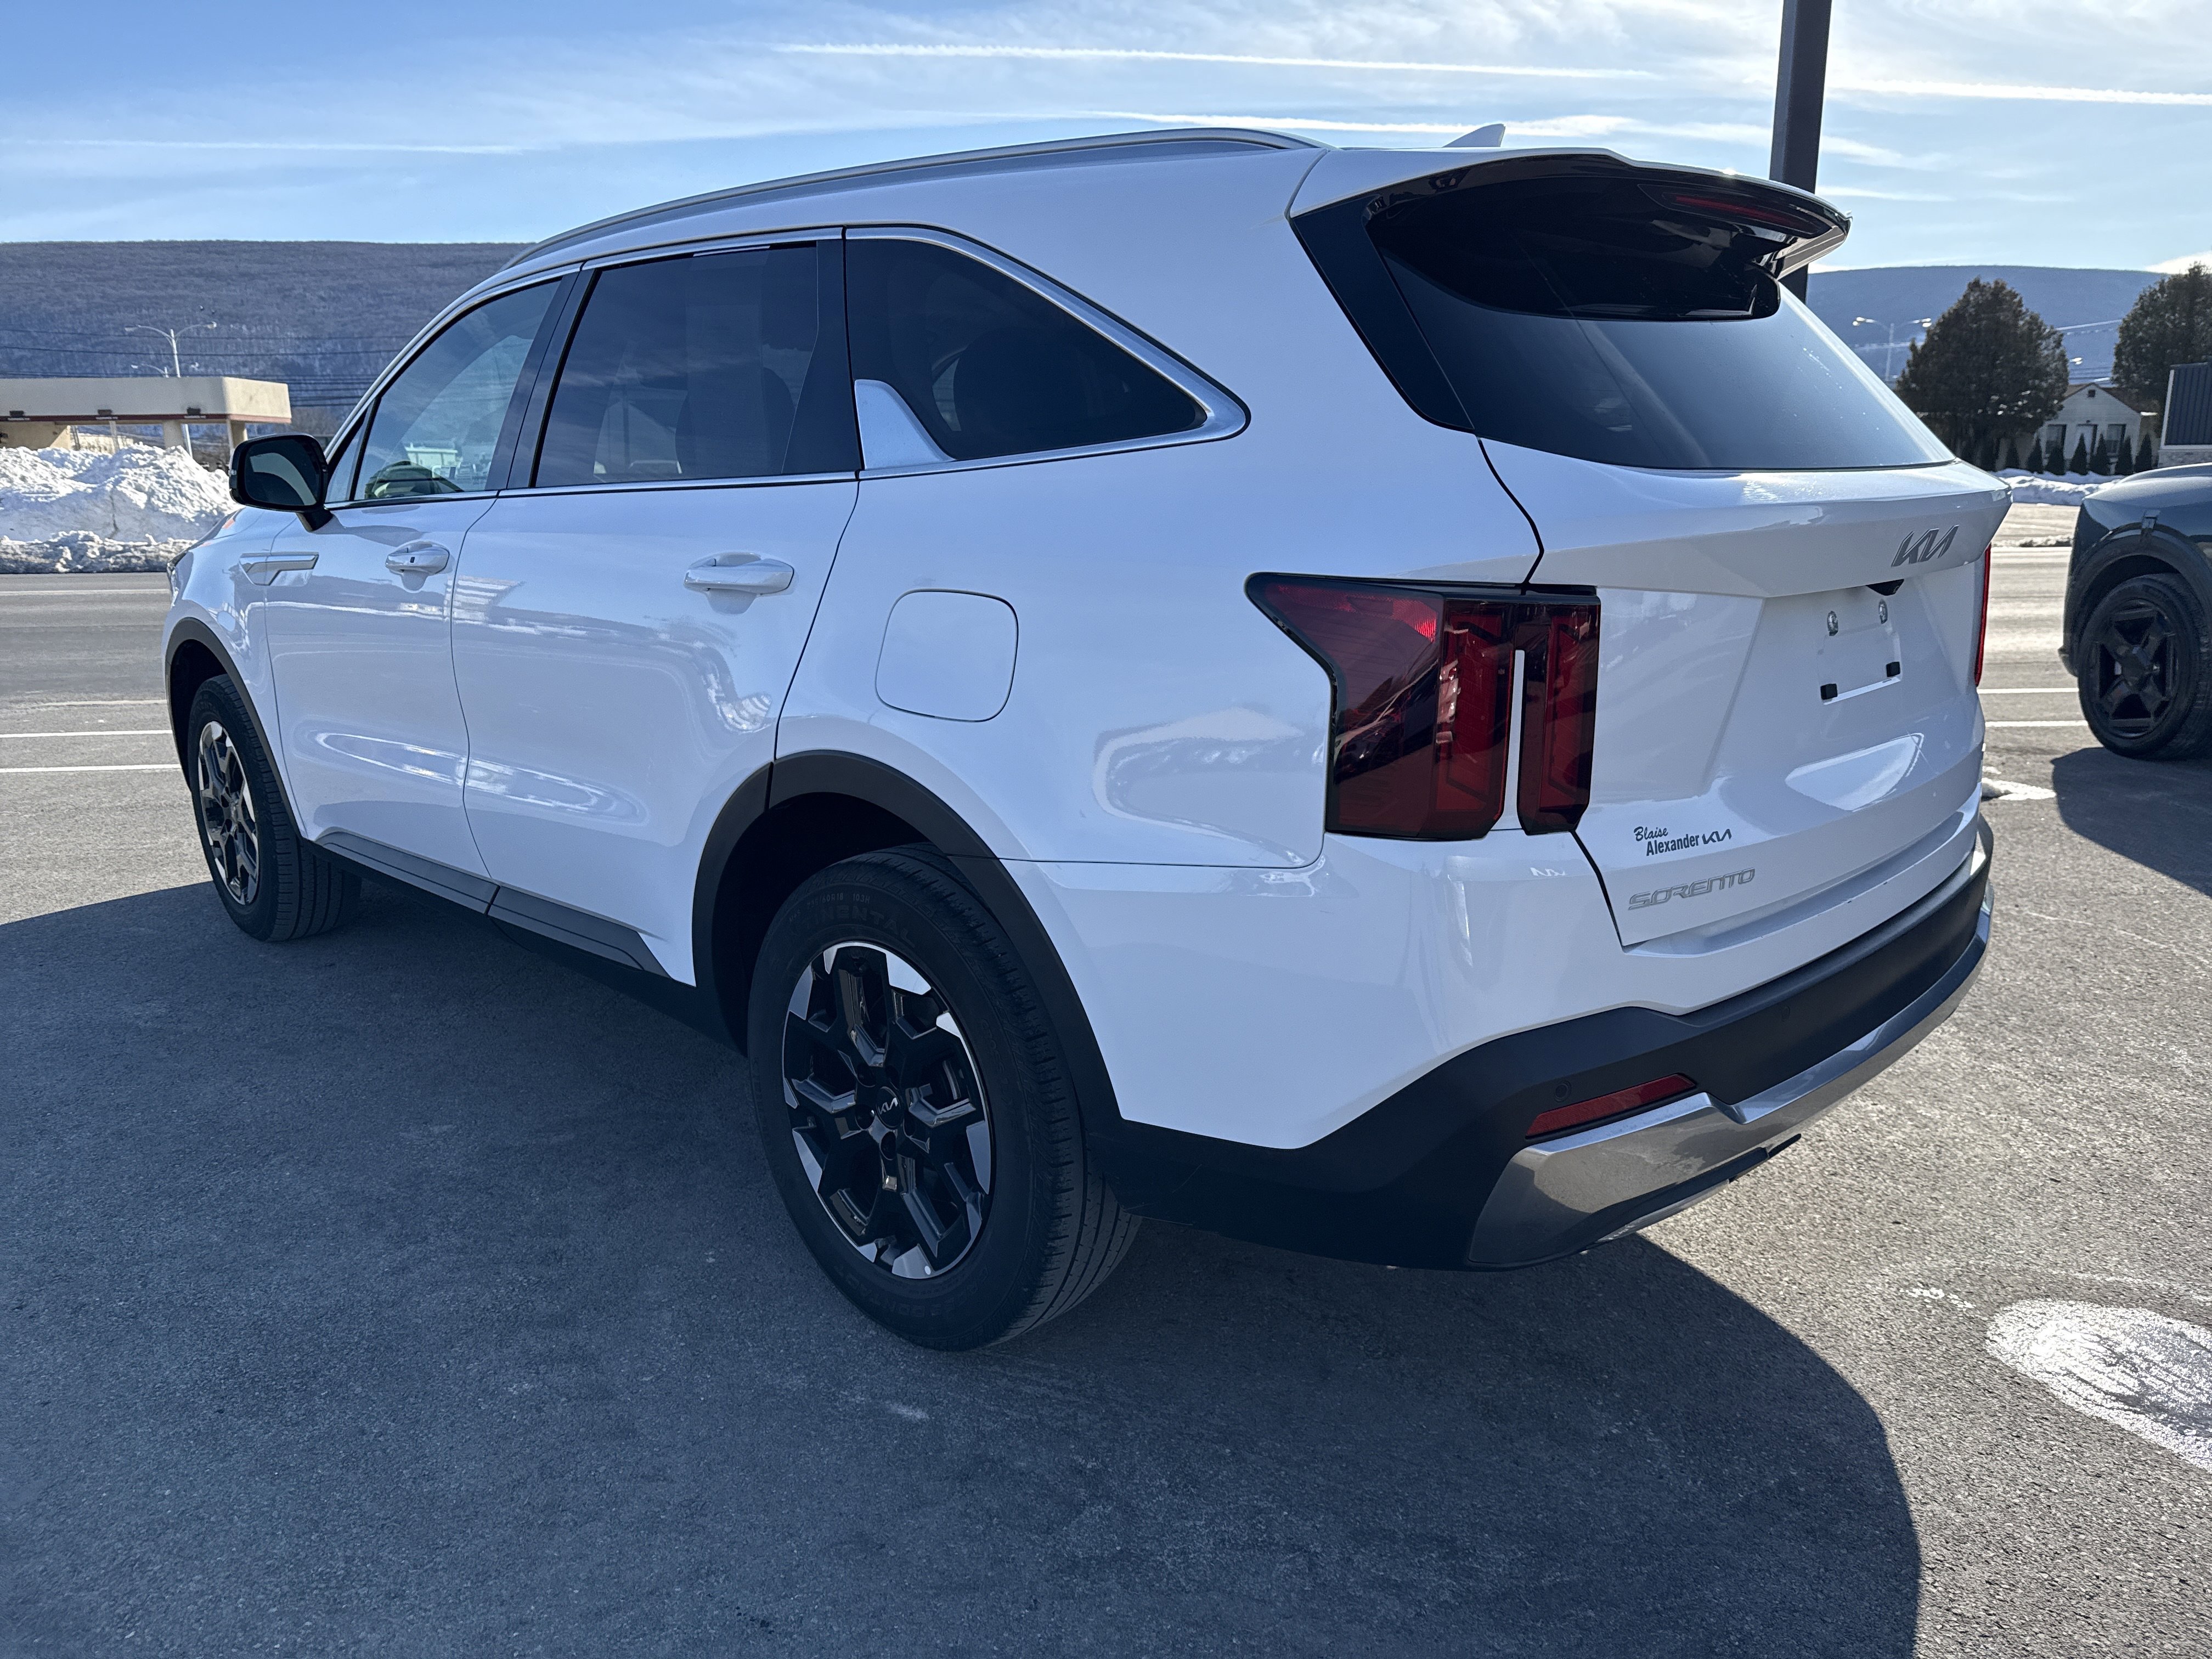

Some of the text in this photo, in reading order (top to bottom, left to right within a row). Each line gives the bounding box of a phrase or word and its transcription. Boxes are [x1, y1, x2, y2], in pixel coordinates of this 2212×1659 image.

[1891, 524, 1960, 567] KIA
[1634, 826, 1668, 842] Blaise
[1646, 828, 1732, 856] Alexander KIA
[853, 893, 870, 904] 103H
[1628, 868, 1755, 910] SORENTO
[878, 1097, 898, 1114] KIA
